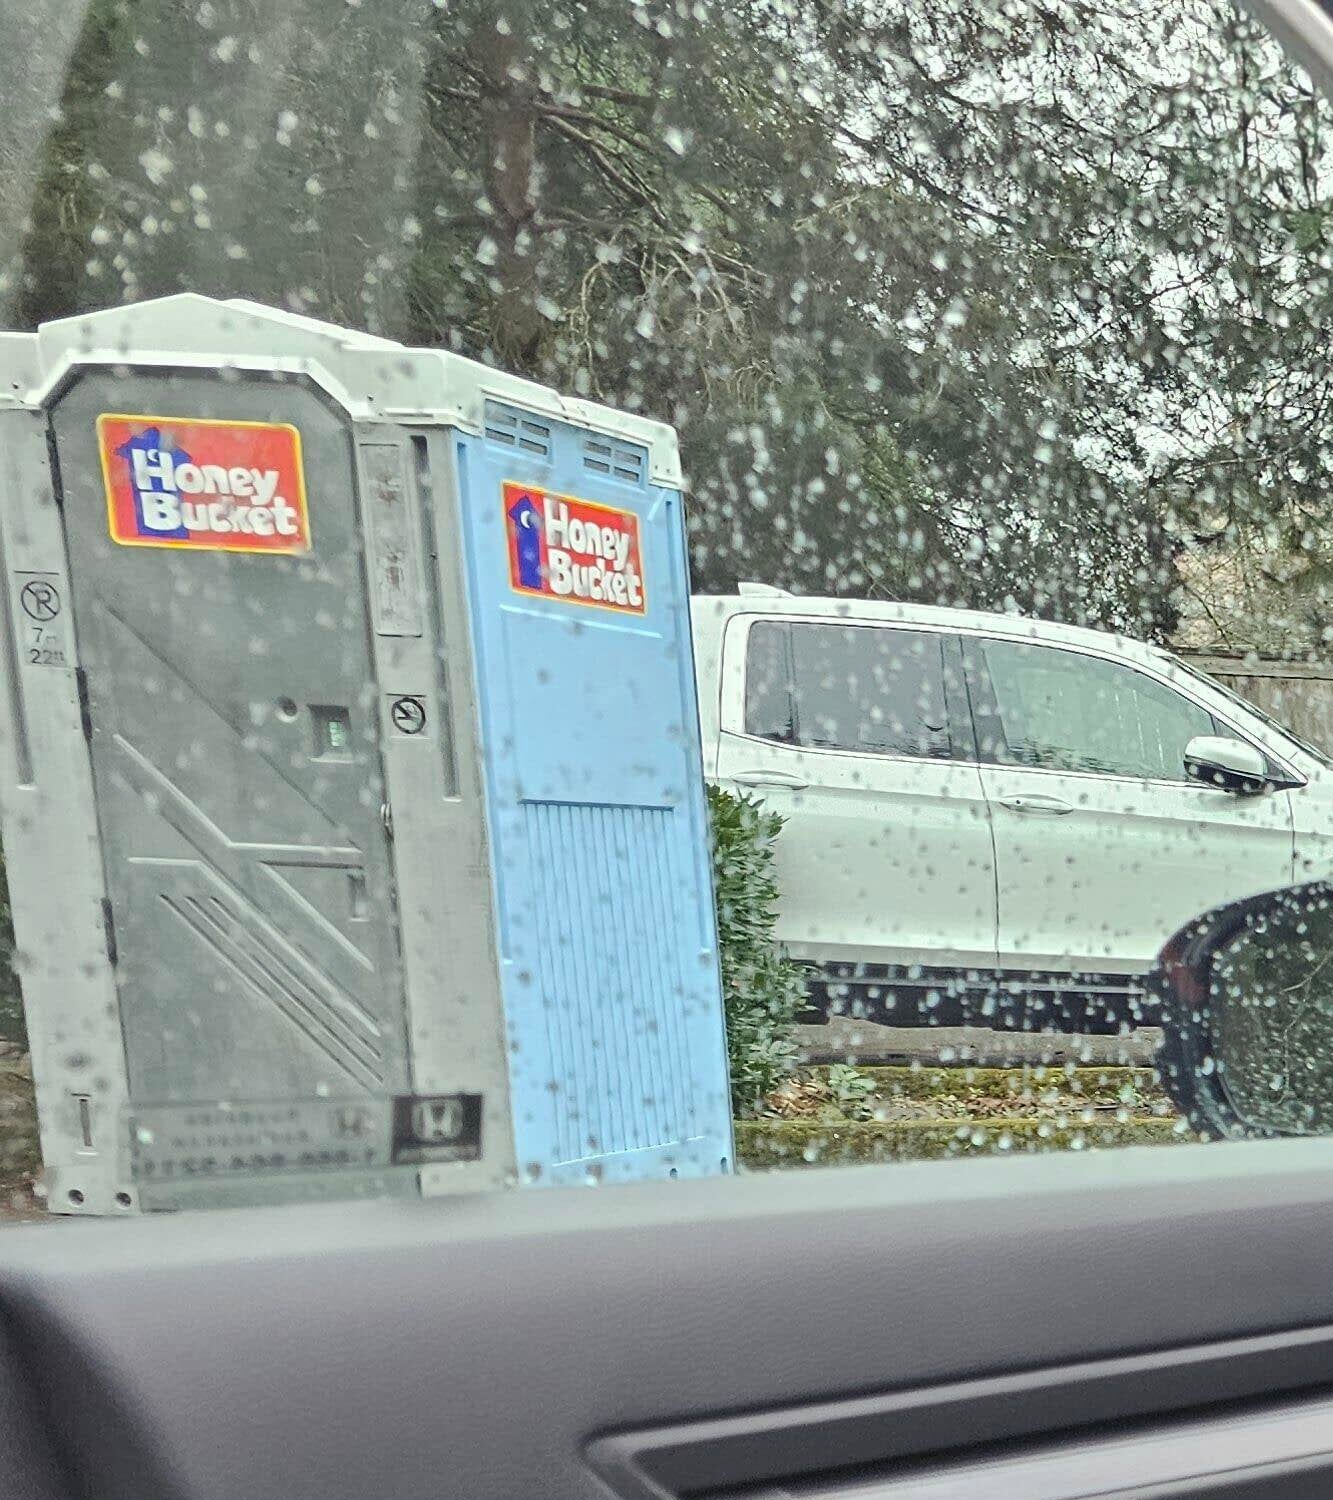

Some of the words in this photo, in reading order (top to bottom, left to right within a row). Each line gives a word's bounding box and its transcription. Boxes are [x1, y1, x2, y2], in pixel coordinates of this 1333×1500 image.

[131, 448, 280, 505] Honey
[140, 491, 298, 535] Bucket
[543, 497, 630, 571] Honey
[547, 548, 643, 607] Bucket
